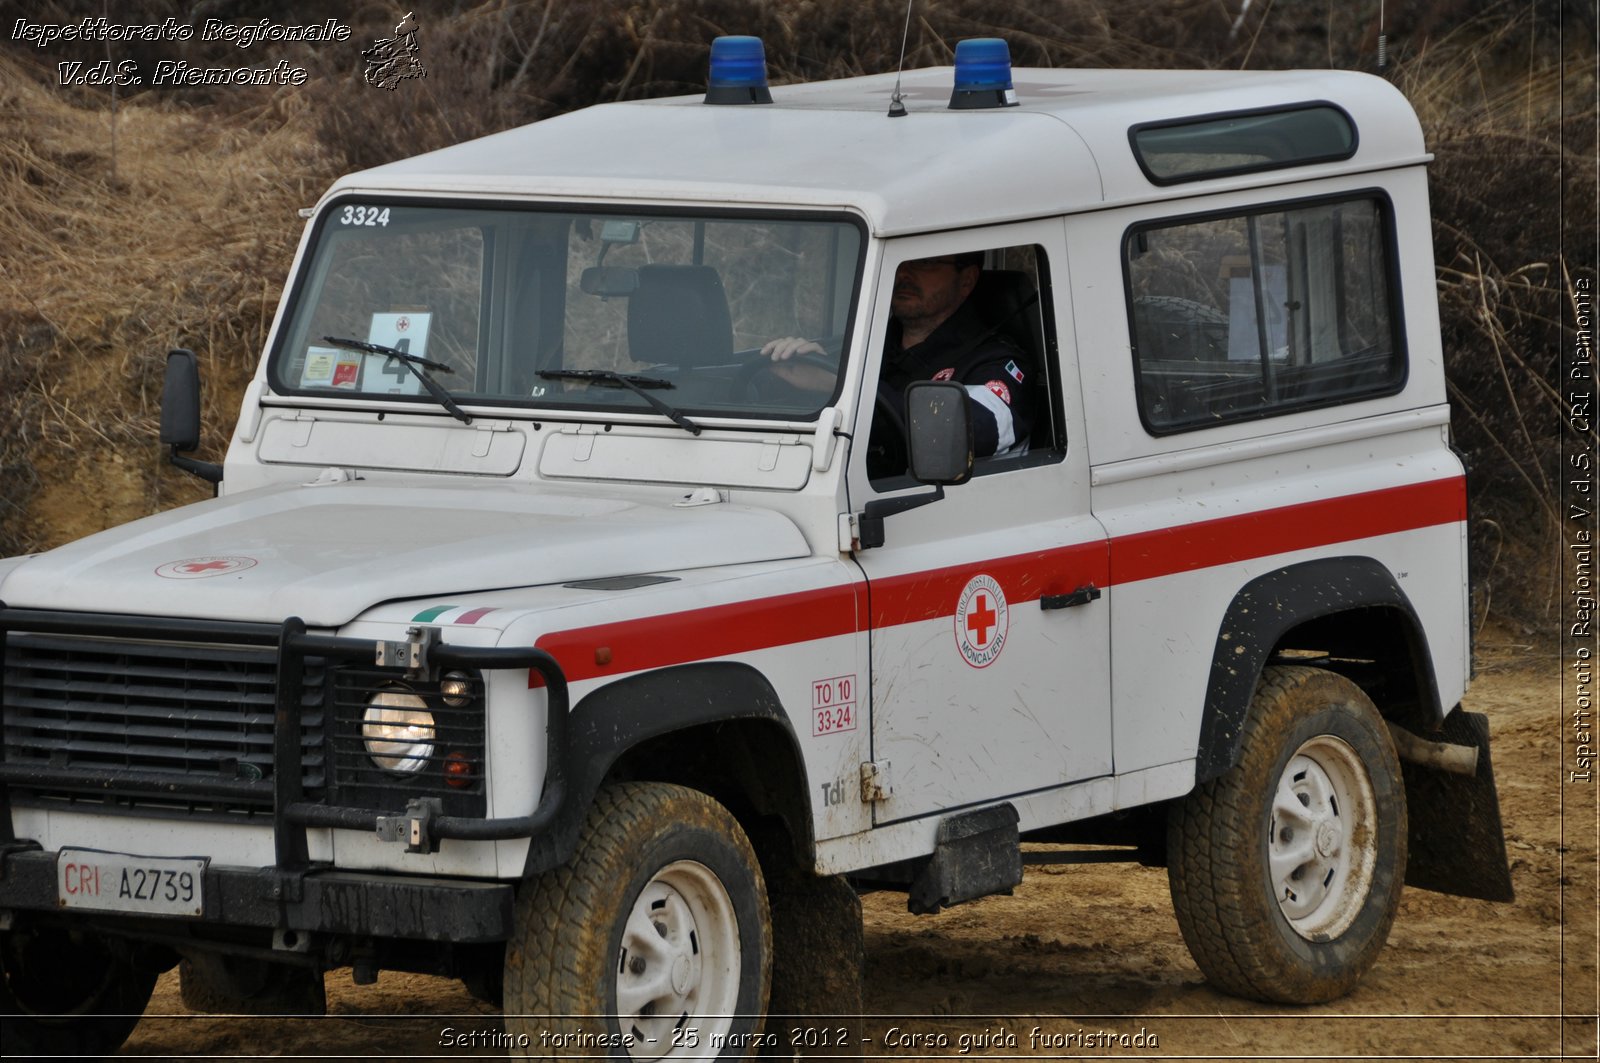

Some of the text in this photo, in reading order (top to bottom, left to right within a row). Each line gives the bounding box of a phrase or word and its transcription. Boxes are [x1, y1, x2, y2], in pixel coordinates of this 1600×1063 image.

[340, 205, 391, 227] 3324
[960, 633, 1004, 665] MONCALIERI
[815, 679, 851, 705] TO 10
[817, 705, 851, 732] 33-24
[821, 777, 845, 807] Tdi
[65, 863, 194, 902] CRI A2739
